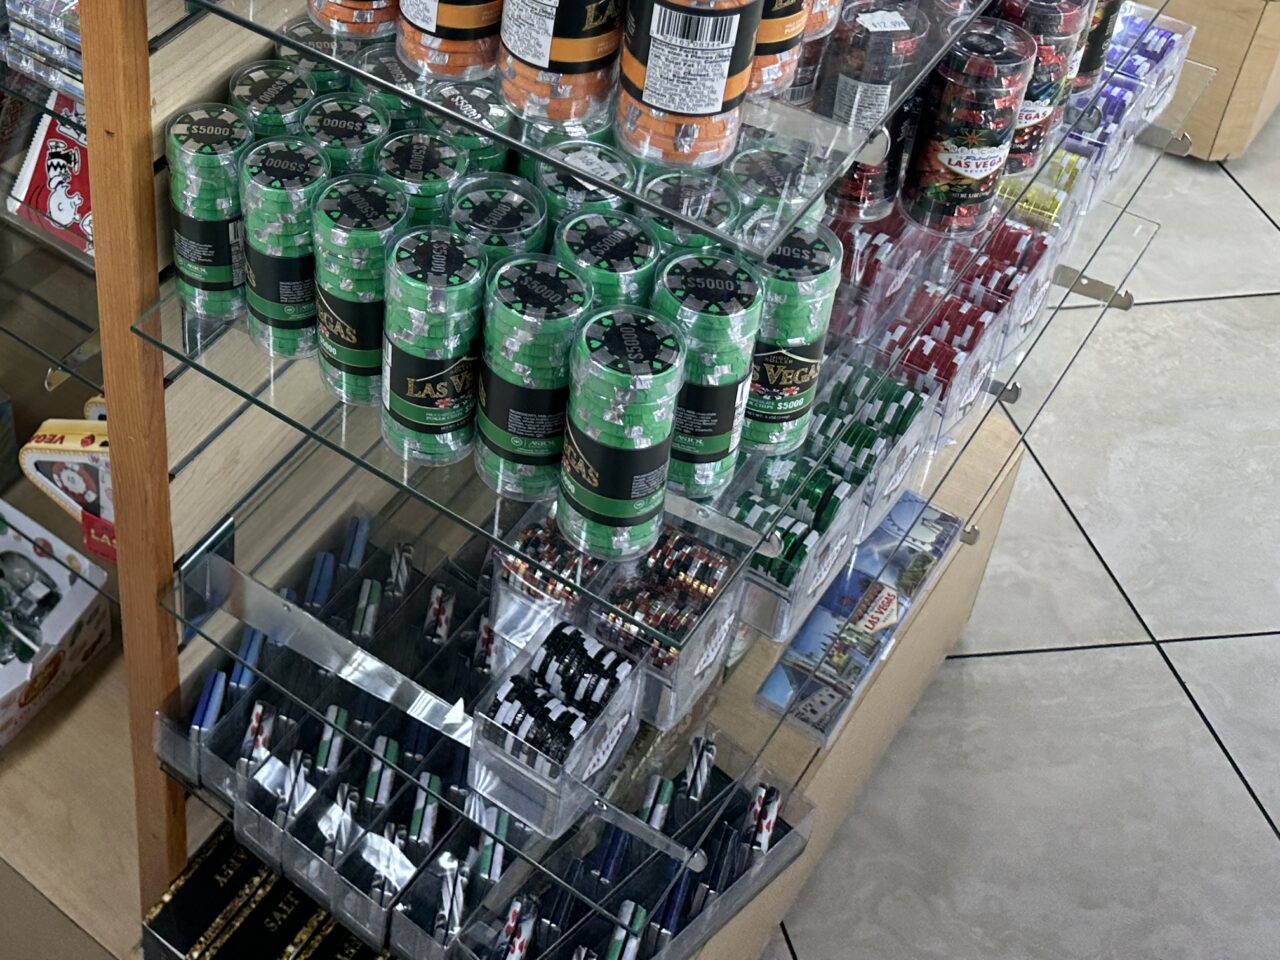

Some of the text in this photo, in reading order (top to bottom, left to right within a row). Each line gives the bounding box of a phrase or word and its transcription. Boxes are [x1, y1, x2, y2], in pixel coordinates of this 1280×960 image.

[258, 79, 288, 103] $5000
[323, 117, 362, 131] $5000
[1018, 110, 1047, 120] EGAS
[190, 125, 230, 136] $5000
[266, 158, 306, 173] $5000
[410, 142, 428, 172] $5000
[947, 157, 1003, 169] LAS VEGA
[348, 193, 378, 218] $5000
[591, 230, 628, 257] $5000
[433, 243, 448, 273] $5000
[520, 276, 562, 304] $5000
[686, 277, 735, 291] $5000
[318, 308, 357, 344] EGAS
[622, 326, 645, 361] $5000
[406, 377, 448, 399] LAS
[777, 398, 804, 410] $5000
[32, 433, 66, 444] VEGA
[864, 592, 896, 631] LAS VEGAS
[213, 848, 249, 888] AFFY
[263, 891, 300, 933] SALT
